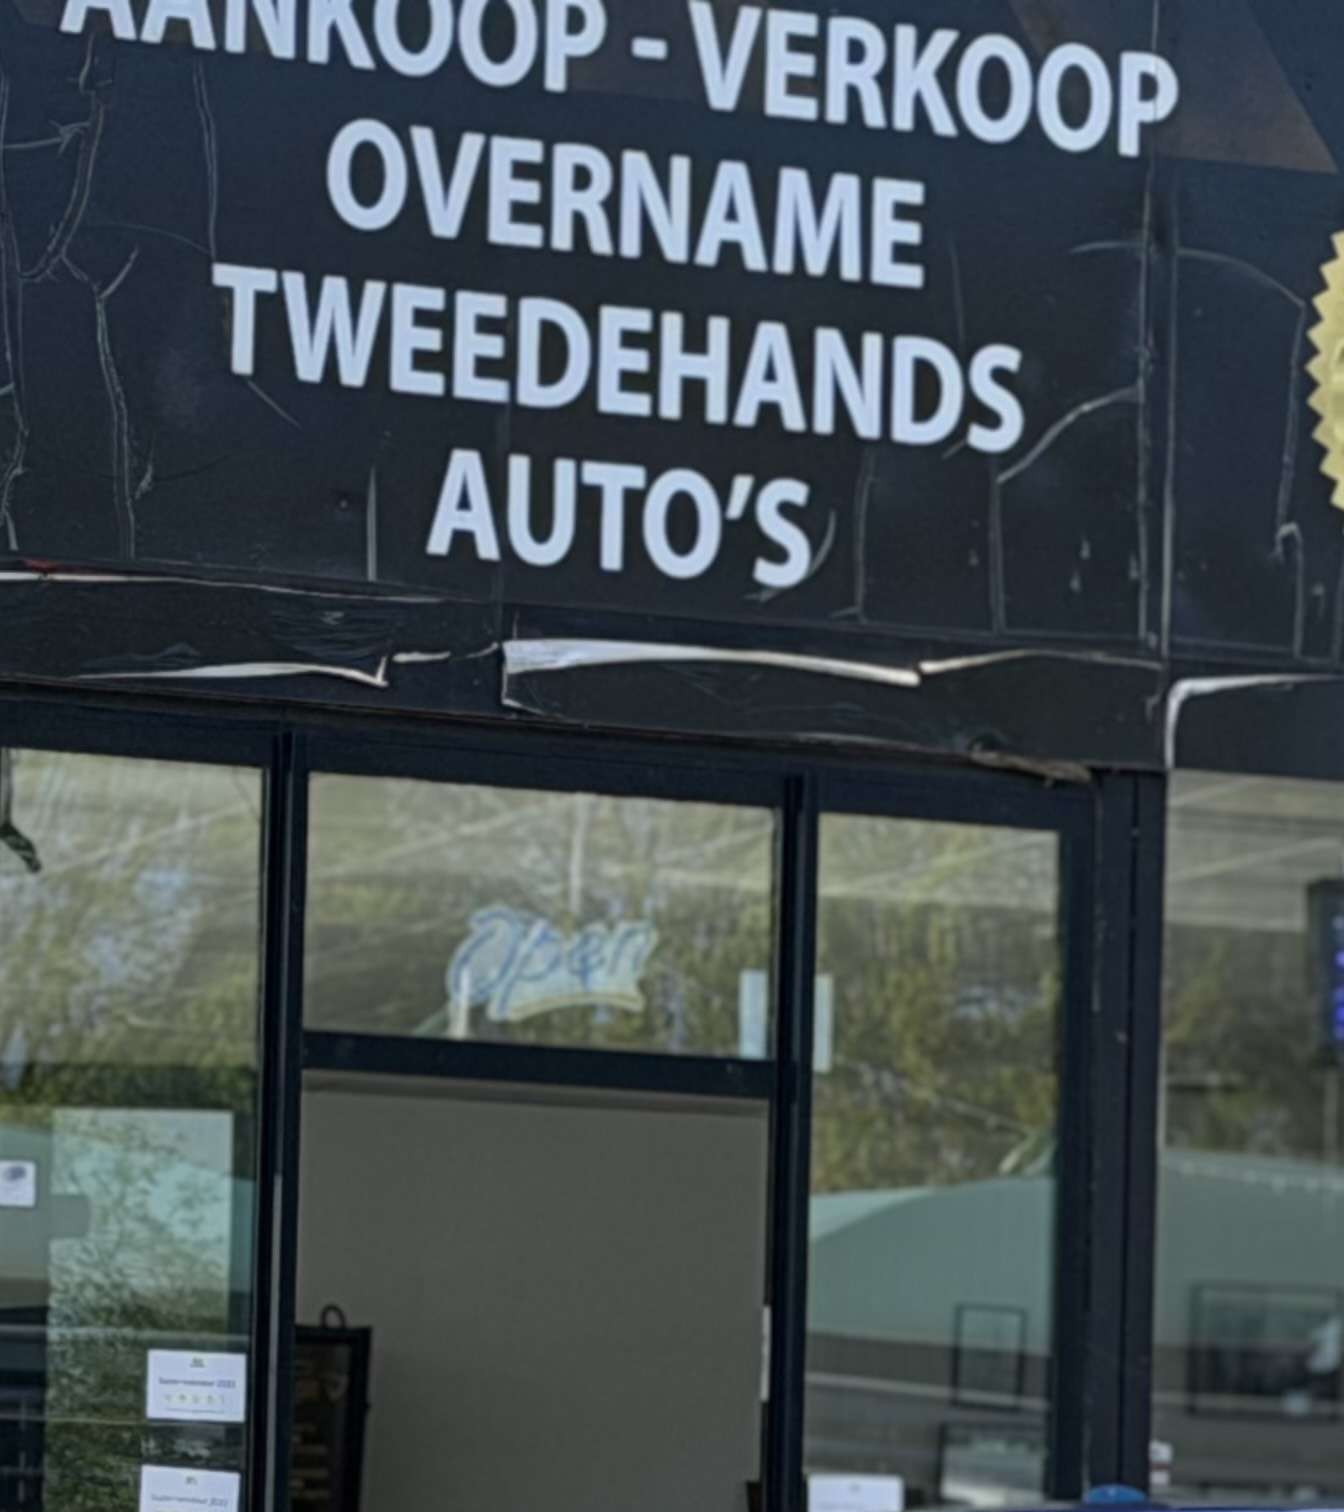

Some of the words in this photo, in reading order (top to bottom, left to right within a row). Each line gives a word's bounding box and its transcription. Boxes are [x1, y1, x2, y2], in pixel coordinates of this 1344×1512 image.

[690, 3, 1178, 157] VERKOOP
[327, 118, 925, 288] OVERNAME
[212, 263, 1025, 453] TWEEDEHANDS
[426, 450, 812, 588] AUTO'S
[453, 906, 656, 1018] Open
